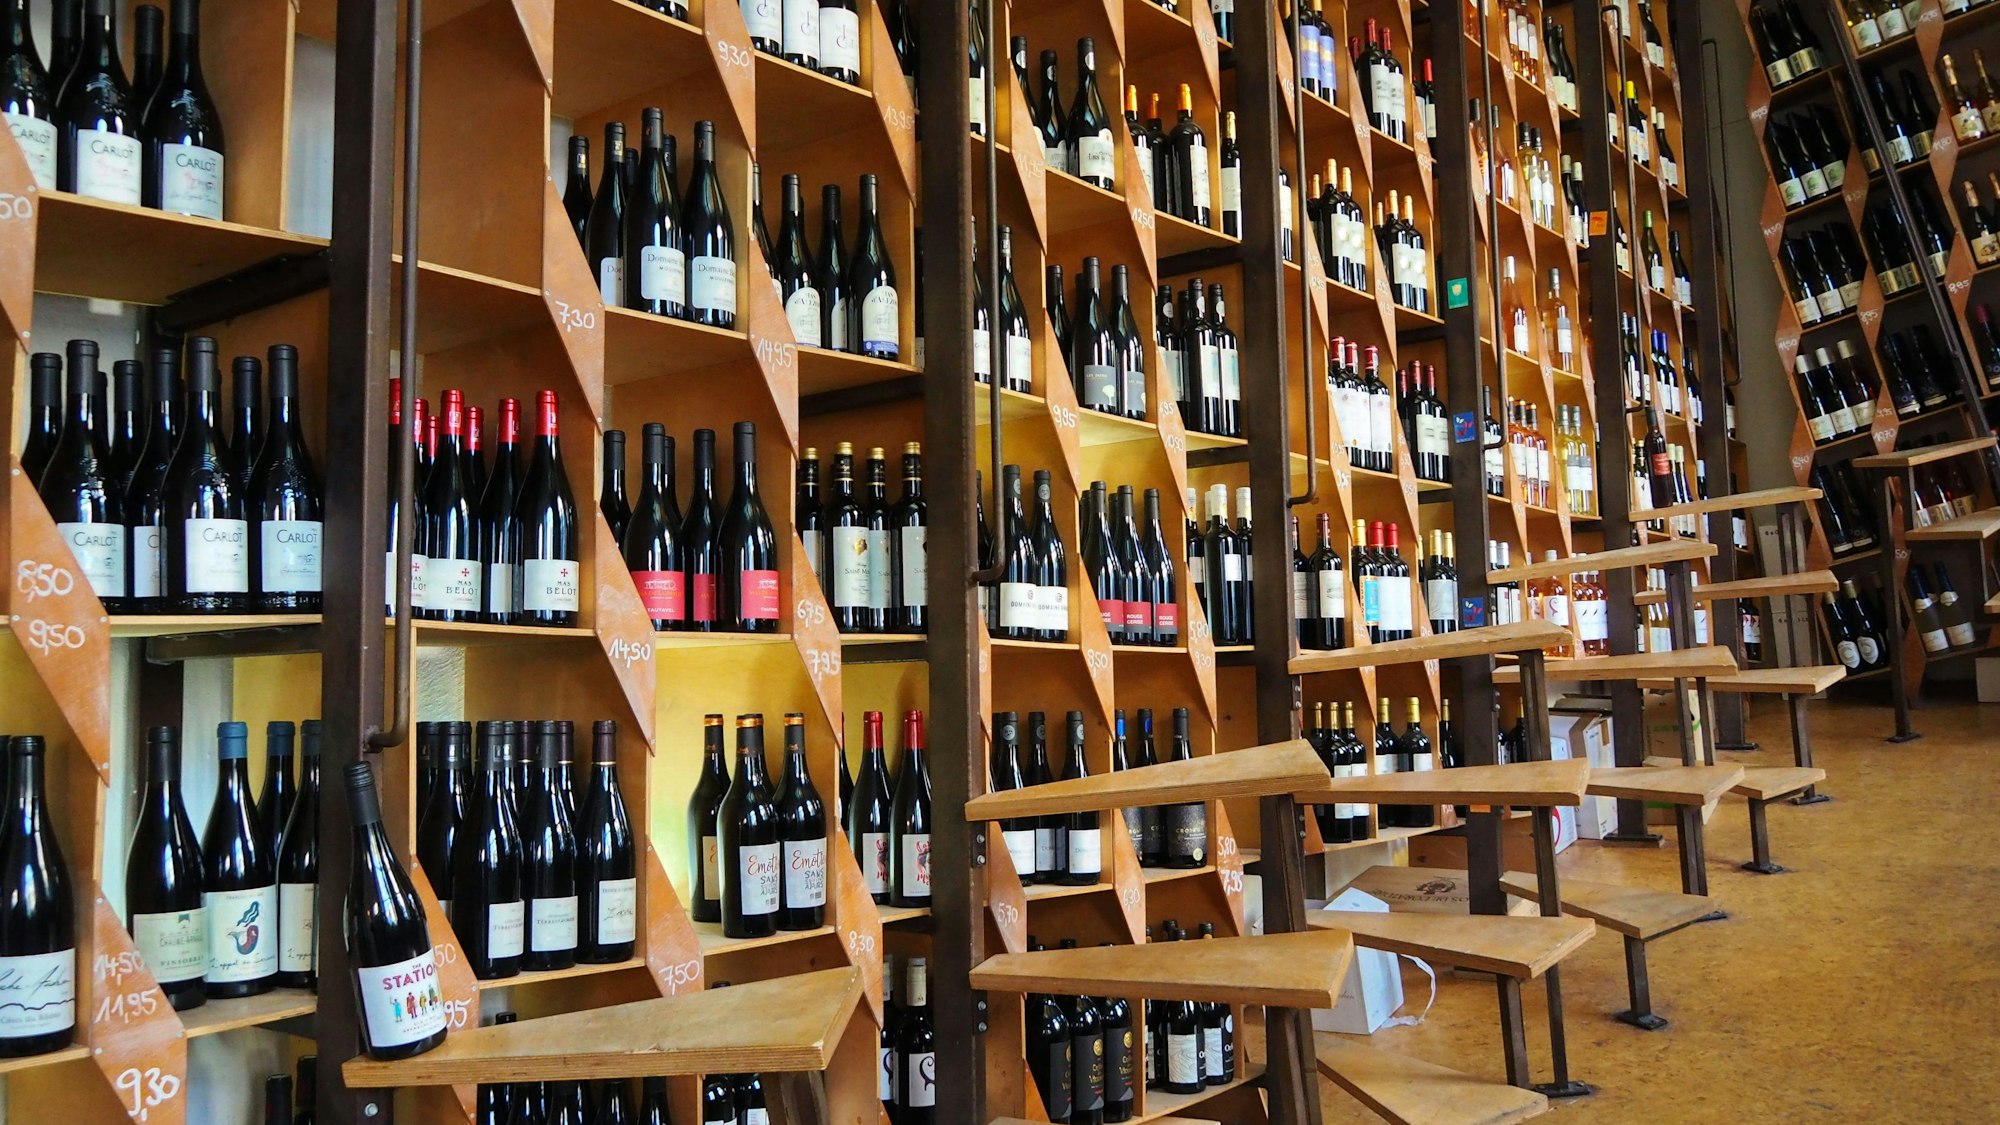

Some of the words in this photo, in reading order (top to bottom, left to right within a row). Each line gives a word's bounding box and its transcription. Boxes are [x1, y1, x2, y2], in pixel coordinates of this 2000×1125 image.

[718, 41, 749, 66] 9,30
[91, 139, 134, 158] CARLOT
[176, 153, 216, 173] CARLOT
[555, 302, 595, 333] 7,30
[73, 531, 117, 547] CARLOT
[203, 527, 242, 544] CARLOT
[276, 528, 318, 545] CARLOT
[412, 583, 426, 592] LOT
[546, 586, 576, 596] BELOT
[29, 619, 86, 656] 9,50
[608, 638, 651, 669] 14,50
[804, 868, 824, 879] SANS
[433, 943, 457, 969] 50
[658, 959, 700, 996] 7,50
[94, 987, 161, 1024] 11,95
[444, 998, 472, 1028] 95
[116, 1067, 181, 1122] 9,30
